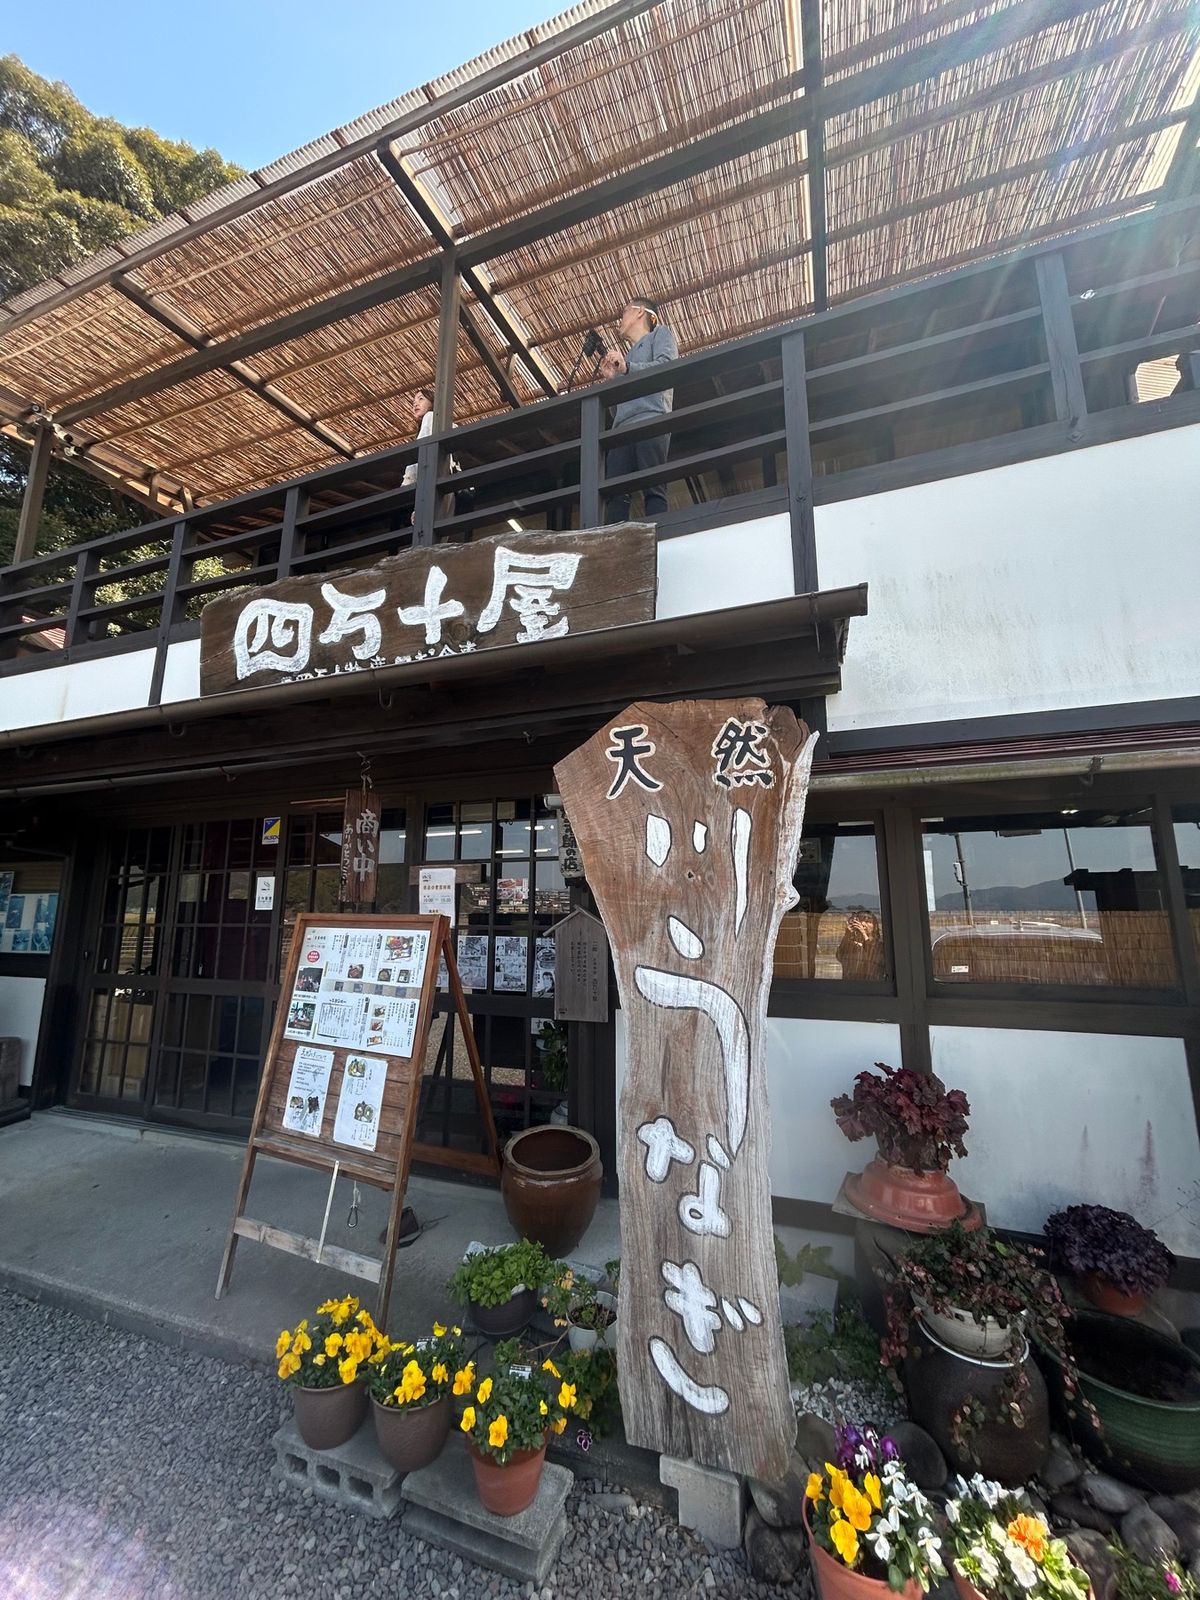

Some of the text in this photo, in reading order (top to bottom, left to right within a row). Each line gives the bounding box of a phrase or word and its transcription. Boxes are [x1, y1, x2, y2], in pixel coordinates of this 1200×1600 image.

[234, 546, 583, 681] 四万十屋
[604, 716, 775, 800] 天然
[353, 808, 380, 882] 商い中
